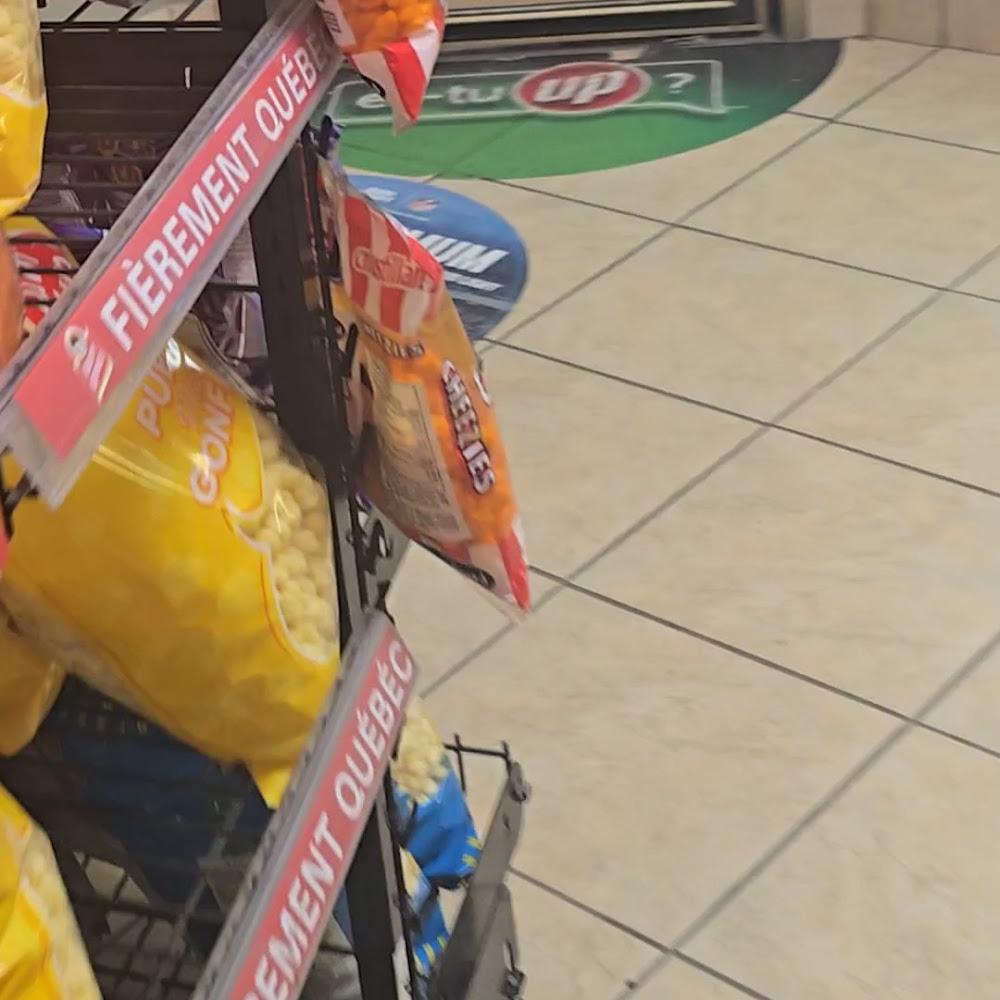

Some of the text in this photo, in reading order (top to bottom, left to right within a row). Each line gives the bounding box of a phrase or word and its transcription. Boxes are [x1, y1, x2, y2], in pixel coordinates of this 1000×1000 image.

[532, 70, 626, 106] up
[101, 123, 263, 353] FIÈREMENT
[441, 359, 496, 496] CHEEZIES
[244, 638, 414, 1000] EMENT QUÉBÉC
